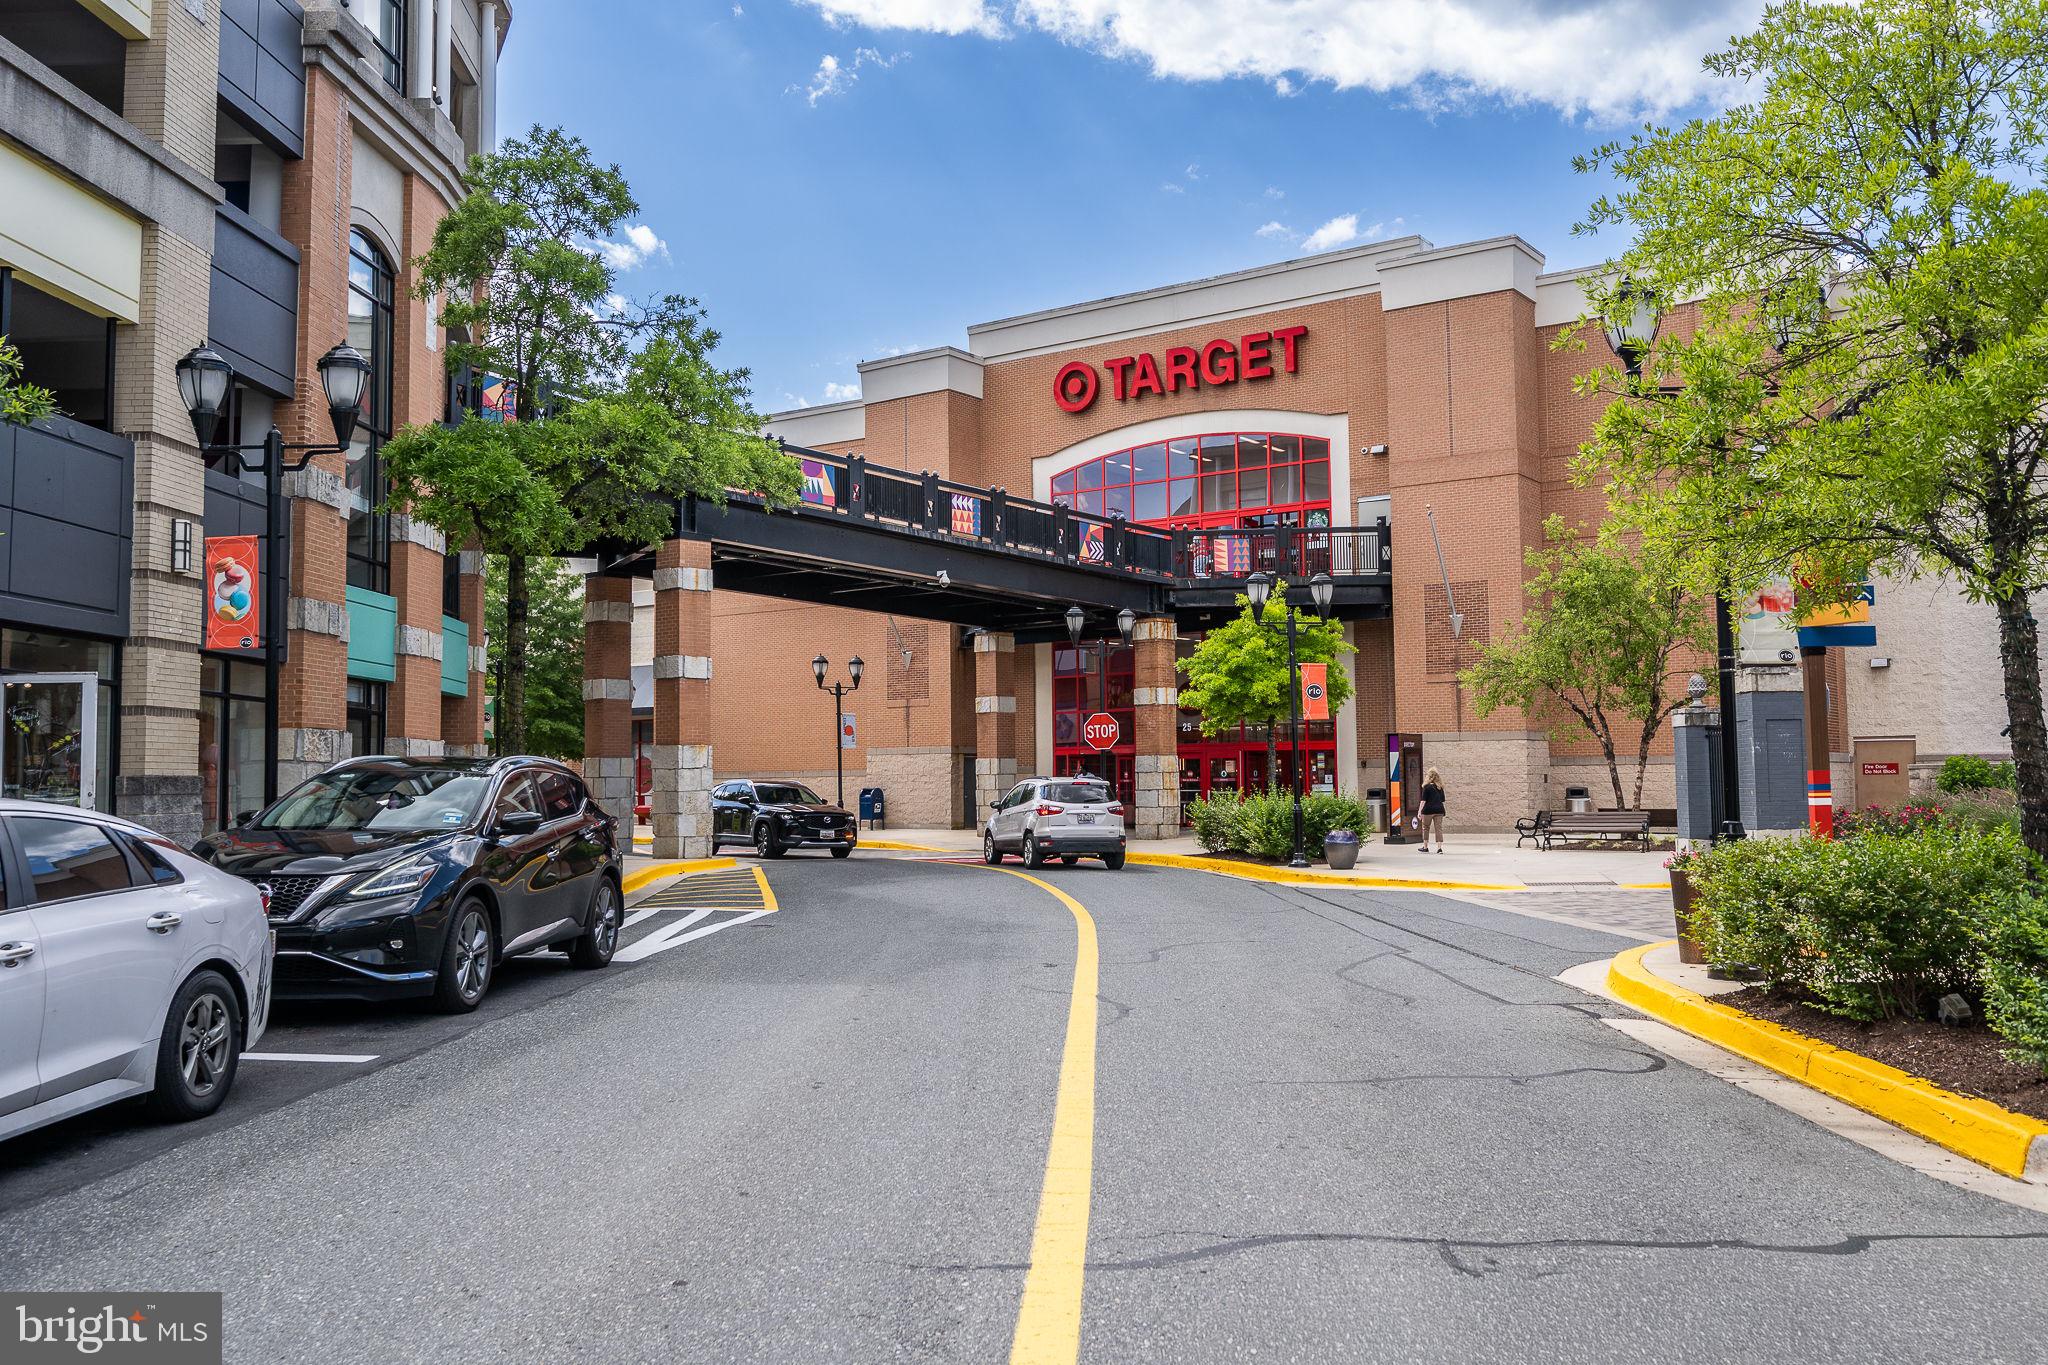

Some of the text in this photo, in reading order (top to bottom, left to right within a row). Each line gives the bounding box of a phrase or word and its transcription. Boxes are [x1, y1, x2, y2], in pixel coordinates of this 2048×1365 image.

[1104, 325, 1308, 401] TARGET
[1308, 687, 1322, 695] rio
[1087, 724, 1117, 739] STOP
[1182, 723, 1192, 732] 25
